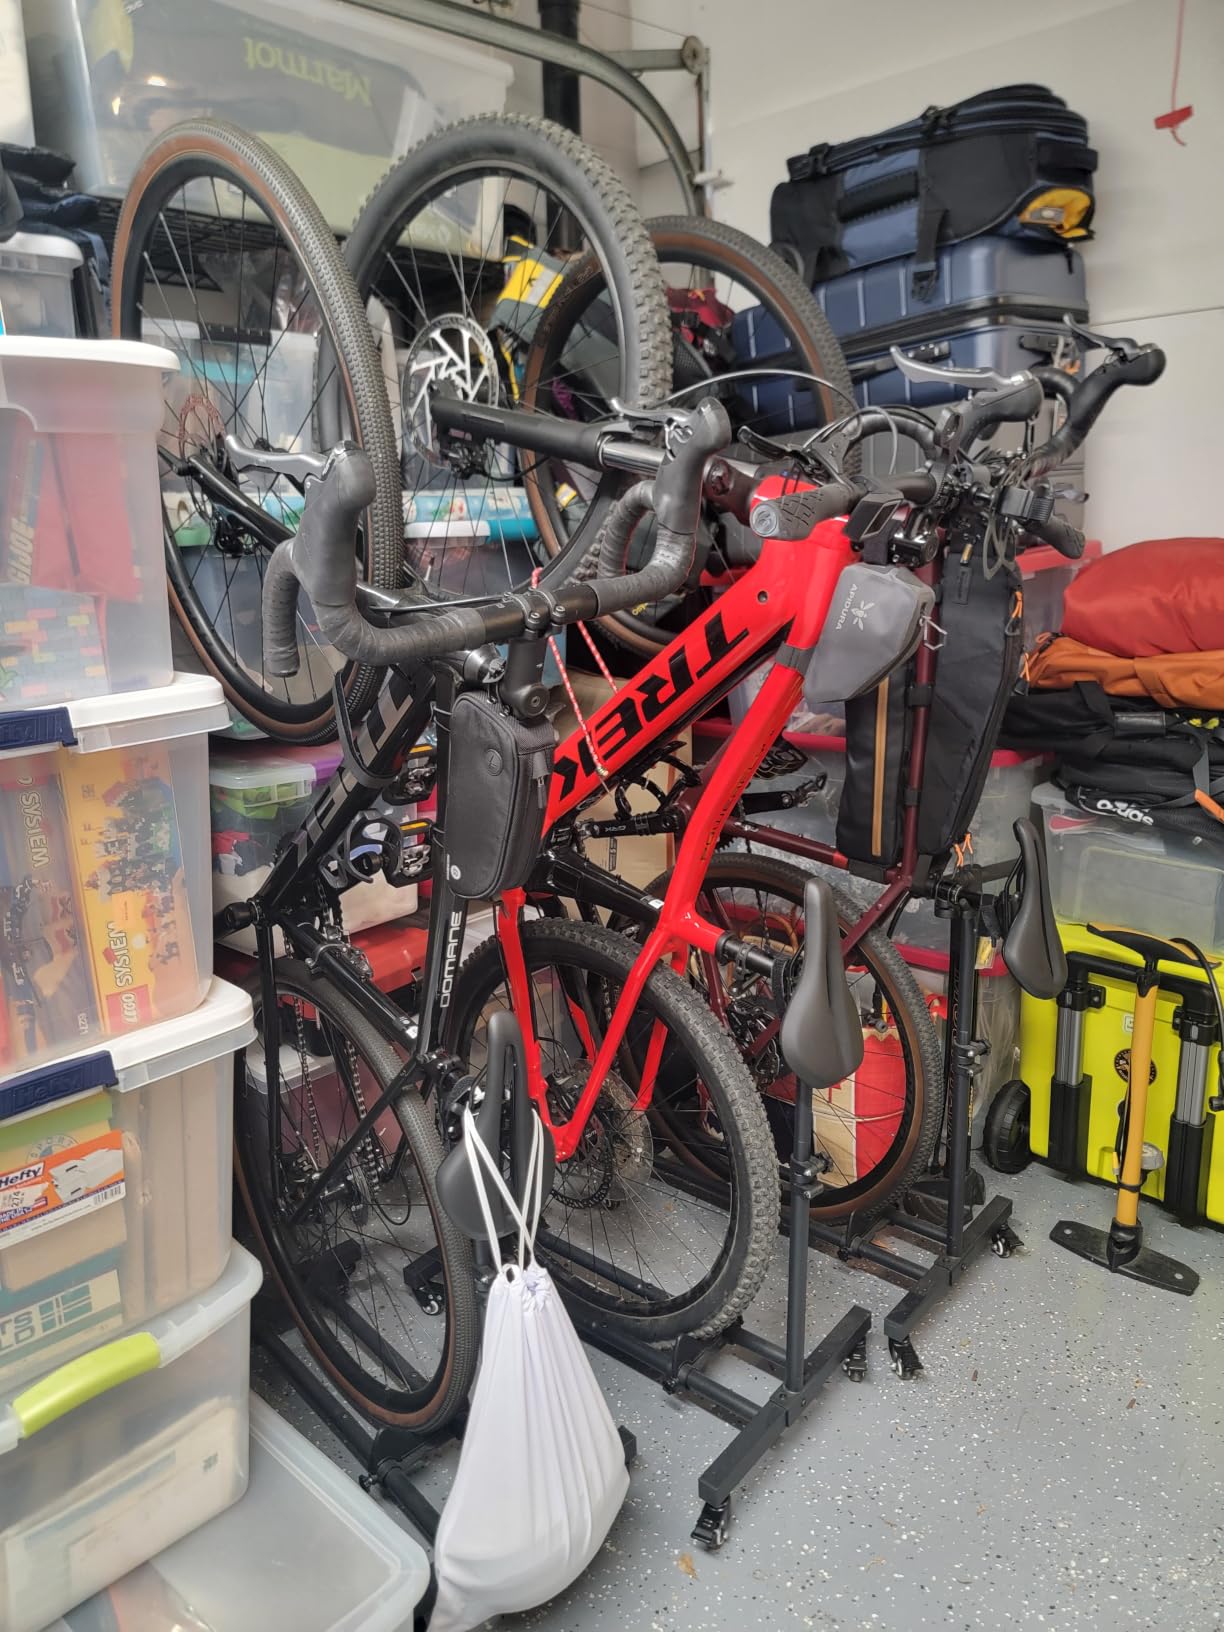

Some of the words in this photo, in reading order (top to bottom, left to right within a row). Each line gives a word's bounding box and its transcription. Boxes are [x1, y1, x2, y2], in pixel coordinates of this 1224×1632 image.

[243, 36, 373, 107] Marmot
[835, 583, 858, 630] APIDURA
[552, 610, 750, 802] TREK
[439, 910, 463, 1009] DOMANE
